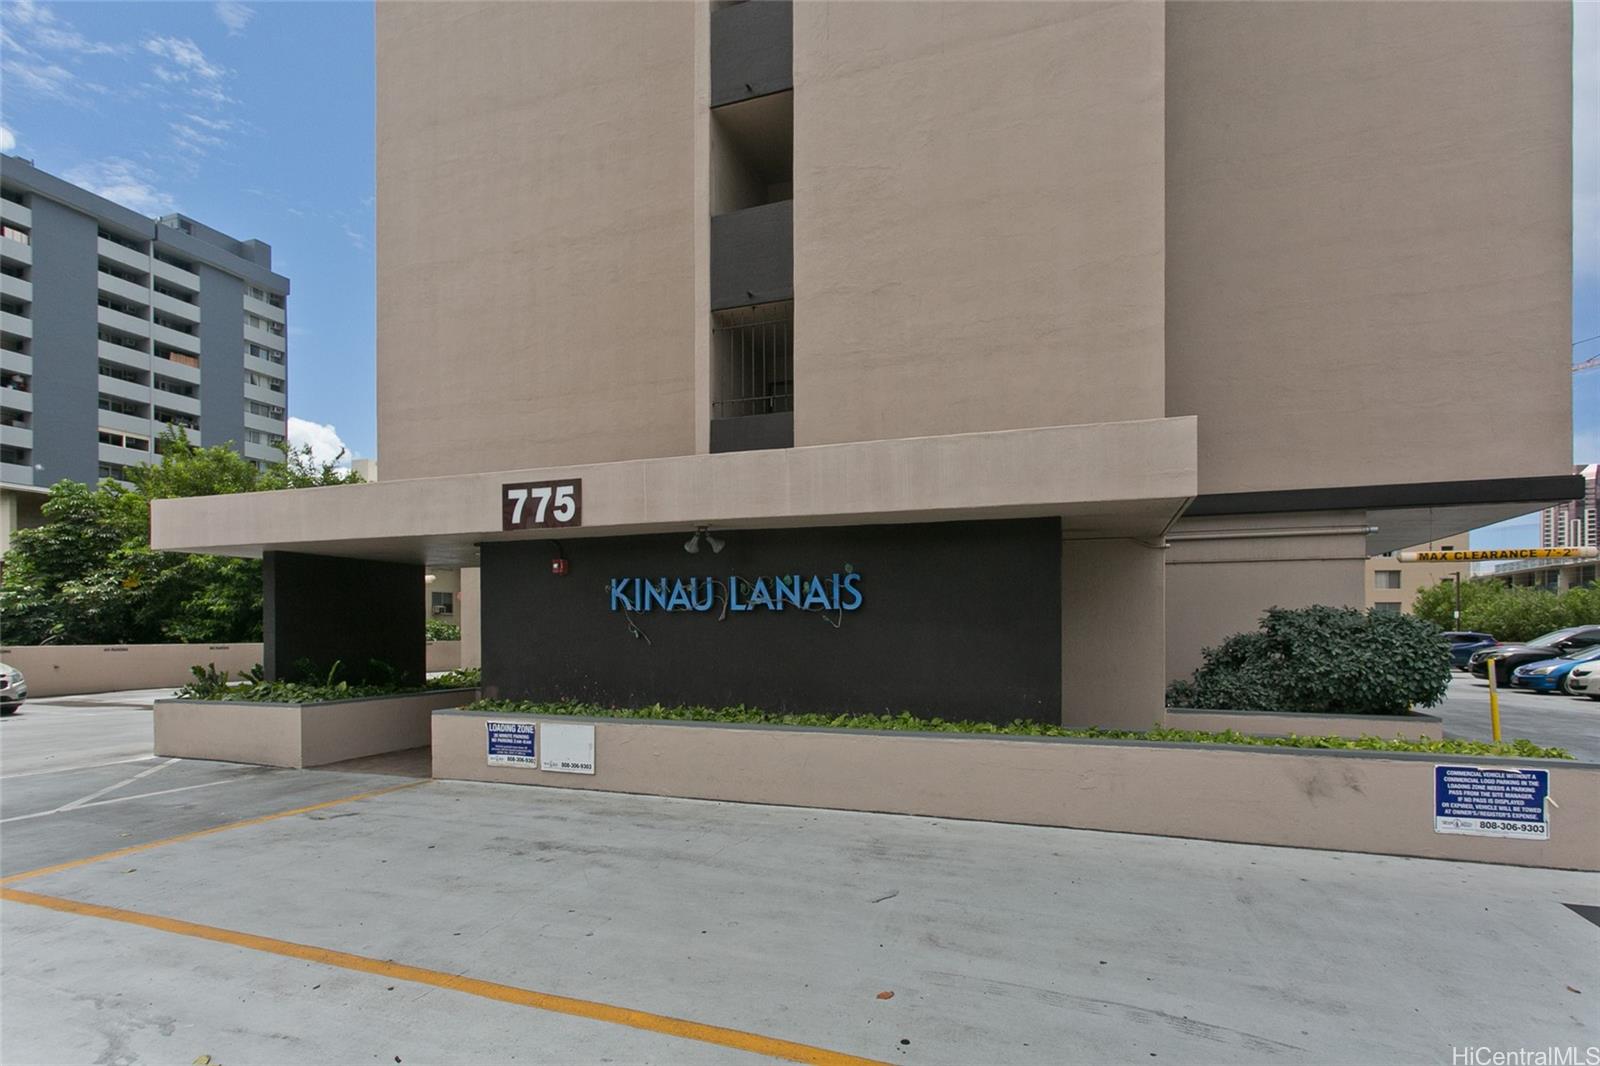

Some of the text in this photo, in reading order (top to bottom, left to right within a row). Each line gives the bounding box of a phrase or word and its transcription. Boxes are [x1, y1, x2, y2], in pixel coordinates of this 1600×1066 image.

[507, 485, 576, 525] 775
[1418, 552, 1448, 561] MAX
[1454, 549, 1537, 560] CLEARANCE
[609, 573, 864, 612] KINAU LANAIS
[489, 723, 534, 734] LOADING ZONE
[561, 762, 592, 770] 808-306-9303
[1443, 776, 1479, 784] COMMERCIAL
[1496, 778, 1520, 786] PARKING
[1494, 798, 1525, 806] DISPLAYED
[1479, 821, 1545, 833] 808-306-9303
